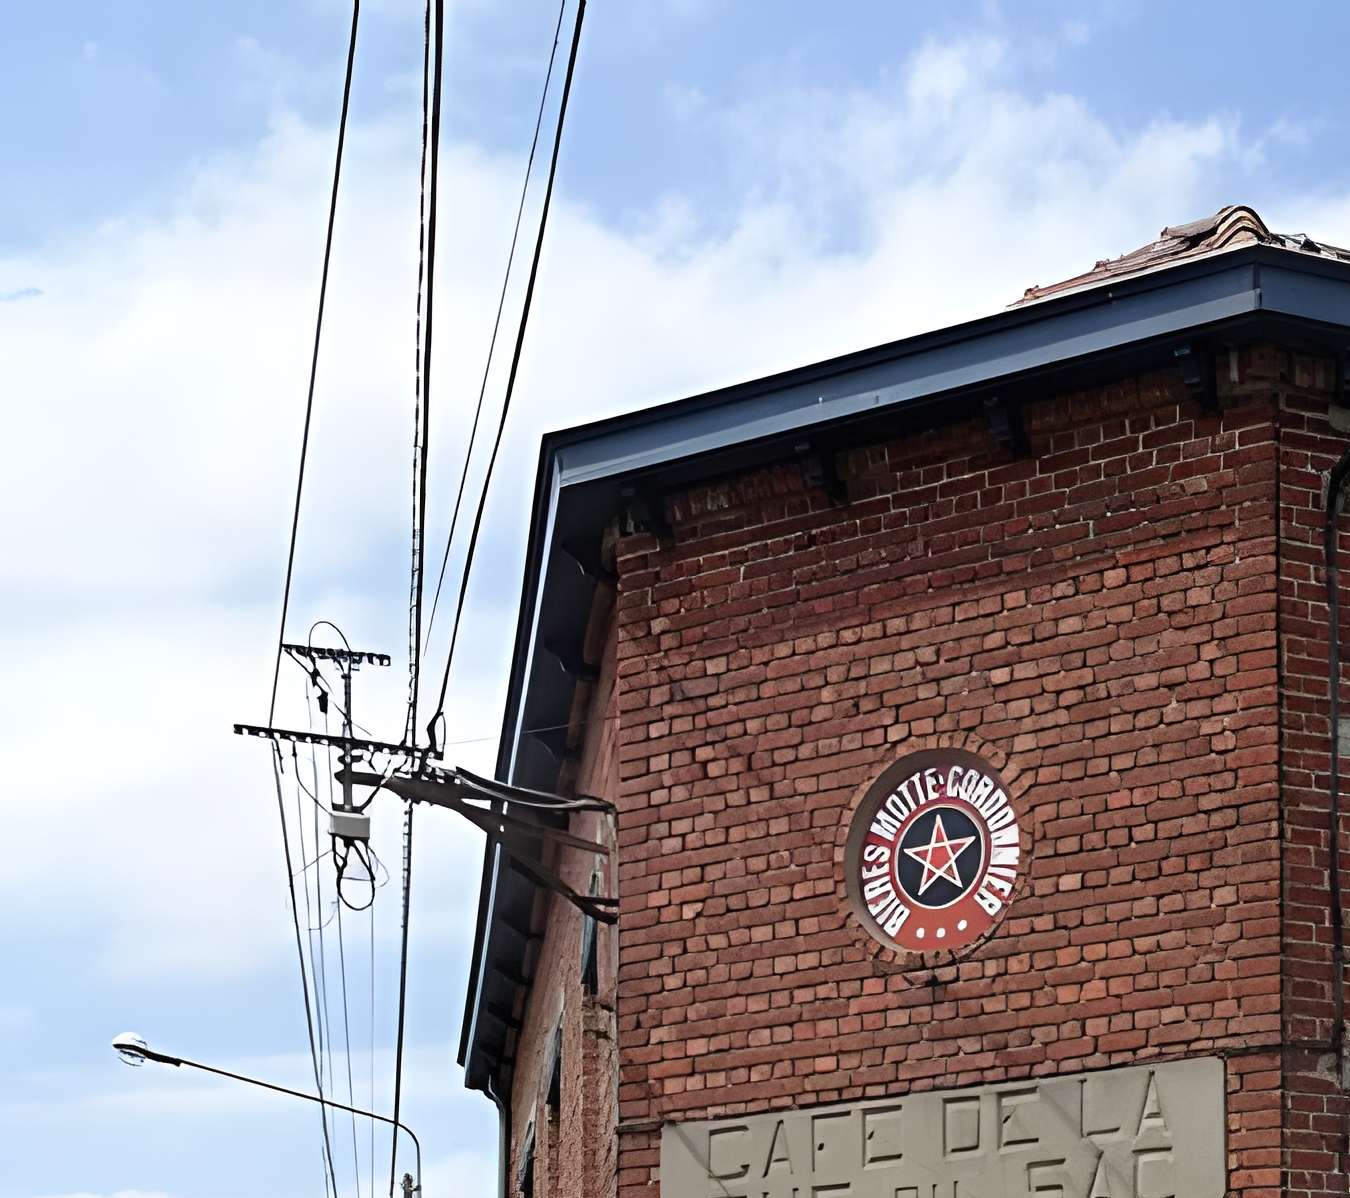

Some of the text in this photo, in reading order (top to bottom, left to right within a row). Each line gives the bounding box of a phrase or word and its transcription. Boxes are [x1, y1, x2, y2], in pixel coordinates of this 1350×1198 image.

[707, 1070, 1172, 1181] CAFE DE LA
